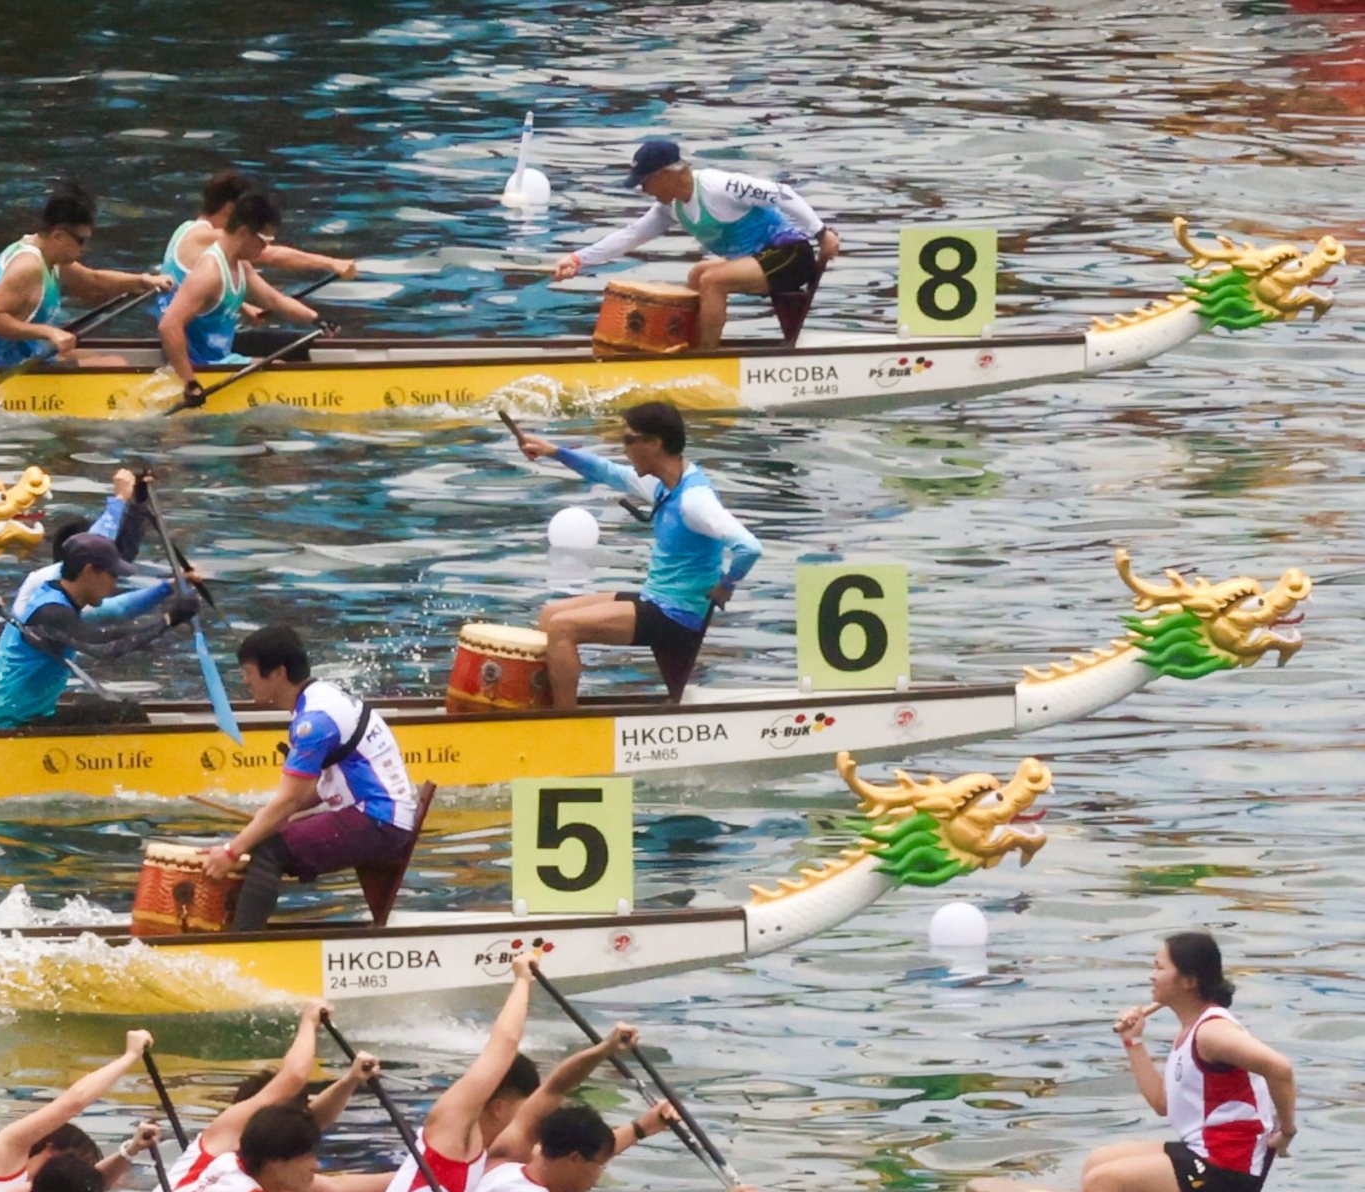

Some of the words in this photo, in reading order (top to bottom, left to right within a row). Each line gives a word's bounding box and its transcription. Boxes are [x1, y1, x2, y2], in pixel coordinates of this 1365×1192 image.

[917, 236, 978, 321] 8
[747, 366, 838, 384] HKCDBA
[2, 395, 26, 411] un
[31, 396, 64, 411] Life
[275, 392, 307, 406] Sun
[311, 392, 343, 406] Life
[411, 391, 442, 405] Sun
[446, 391, 476, 402] Life
[818, 574, 887, 672] 6
[621, 724, 728, 746] HKCDBA
[761, 726, 810, 739] PS-BuK
[76, 754, 113, 771] Sun
[118, 753, 153, 770] Life
[232, 752, 267, 768] Sun
[427, 749, 460, 764] Life
[625, 749, 679, 763] 24-M65
[536, 788, 609, 892] 5
[328, 950, 441, 971] HKCDBA
[475, 952, 521, 965] PS-Bu
[330, 974, 387, 988] 24-M63
